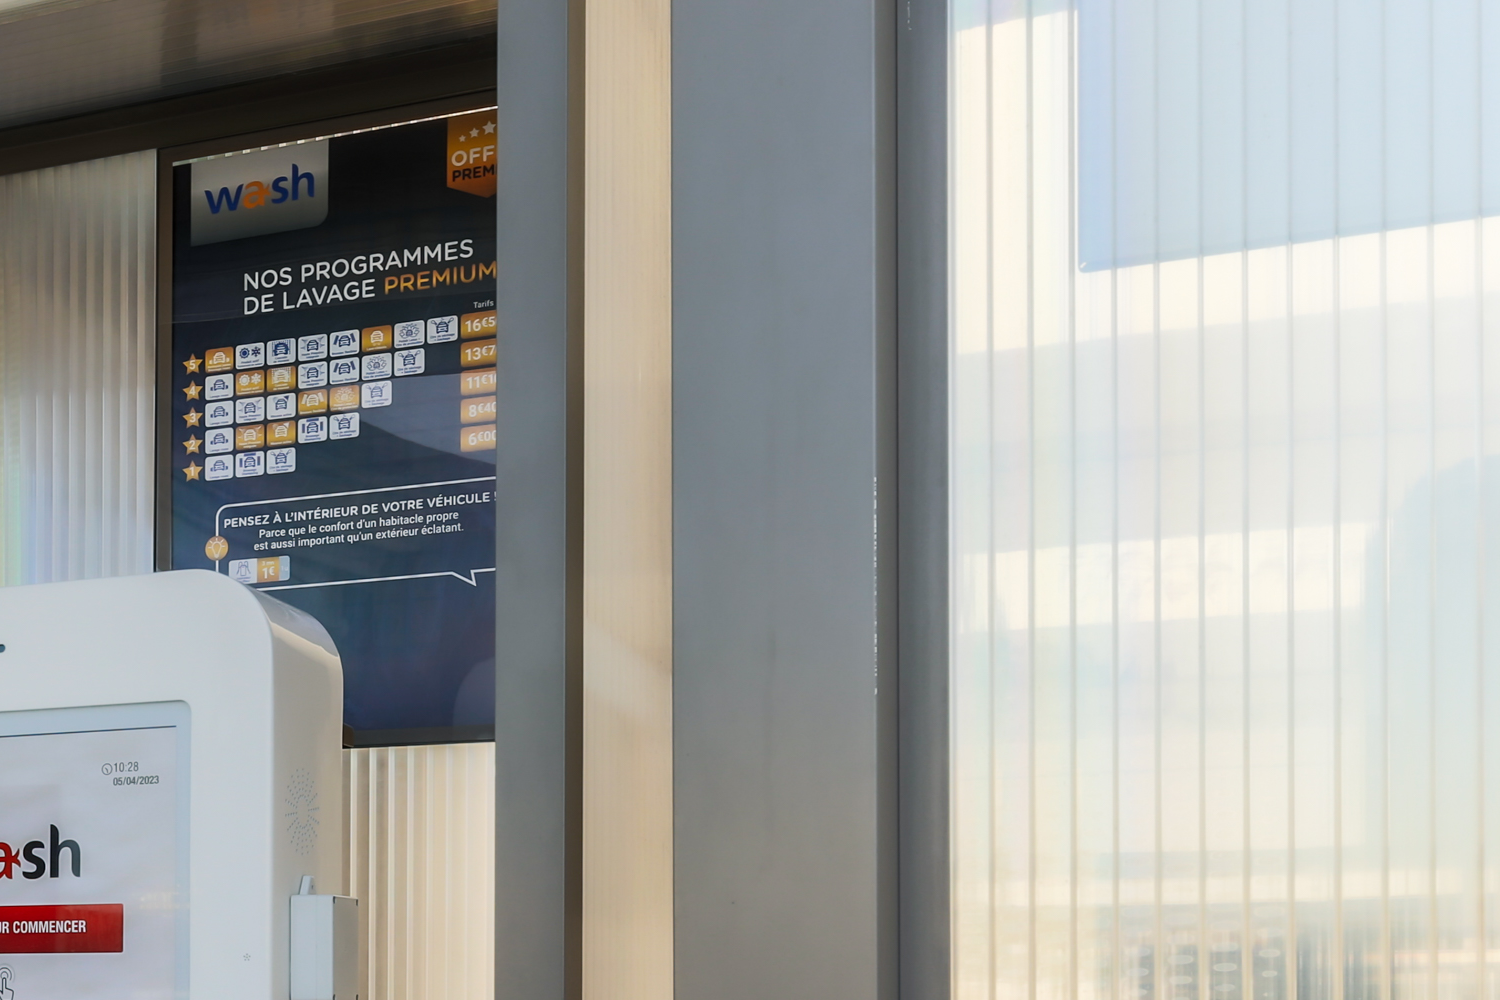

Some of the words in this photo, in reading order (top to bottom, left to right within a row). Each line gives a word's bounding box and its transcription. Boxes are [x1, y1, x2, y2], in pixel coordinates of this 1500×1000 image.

[204, 163, 316, 215] wash
[244, 266, 293, 292] NOS
[301, 238, 474, 283] PROGRAMMES
[244, 293, 275, 315] DE
[283, 278, 376, 310] LAVAGE
[384, 261, 497, 294] PREMIUM
[473, 300, 494, 309] Tarifs
[464, 315, 497, 333] 16€5
[464, 344, 497, 361] 13€7
[189, 360, 196, 370] 5
[189, 386, 196, 396] 4
[189, 412, 196, 423] 3
[189, 440, 196, 450] 2
[189, 466, 195, 476] 1
[223, 514, 270, 529] PENSEZ
[272, 510, 282, 524] À
[361, 503, 379, 515] DE
[381, 498, 424, 513] VOTRE
[426, 491, 491, 508] VÉHICULE
[258, 528, 286, 539] Parce
[288, 527, 307, 538] que
[308, 524, 317, 534] le
[319, 520, 355, 533] confort
[379, 513, 424, 527] habitacle
[426, 511, 459, 525] propre
[253, 541, 269, 551] est
[270, 537, 296, 550] aussi
[297, 534, 345, 548] important
[375, 527, 419, 540] extérieur
[421, 522, 464, 535] éclatant.
[113, 761, 140, 773] 10:28
[112, 775, 160, 787] 05/04/2023
[12, 920, 87, 934] COMMENCER
